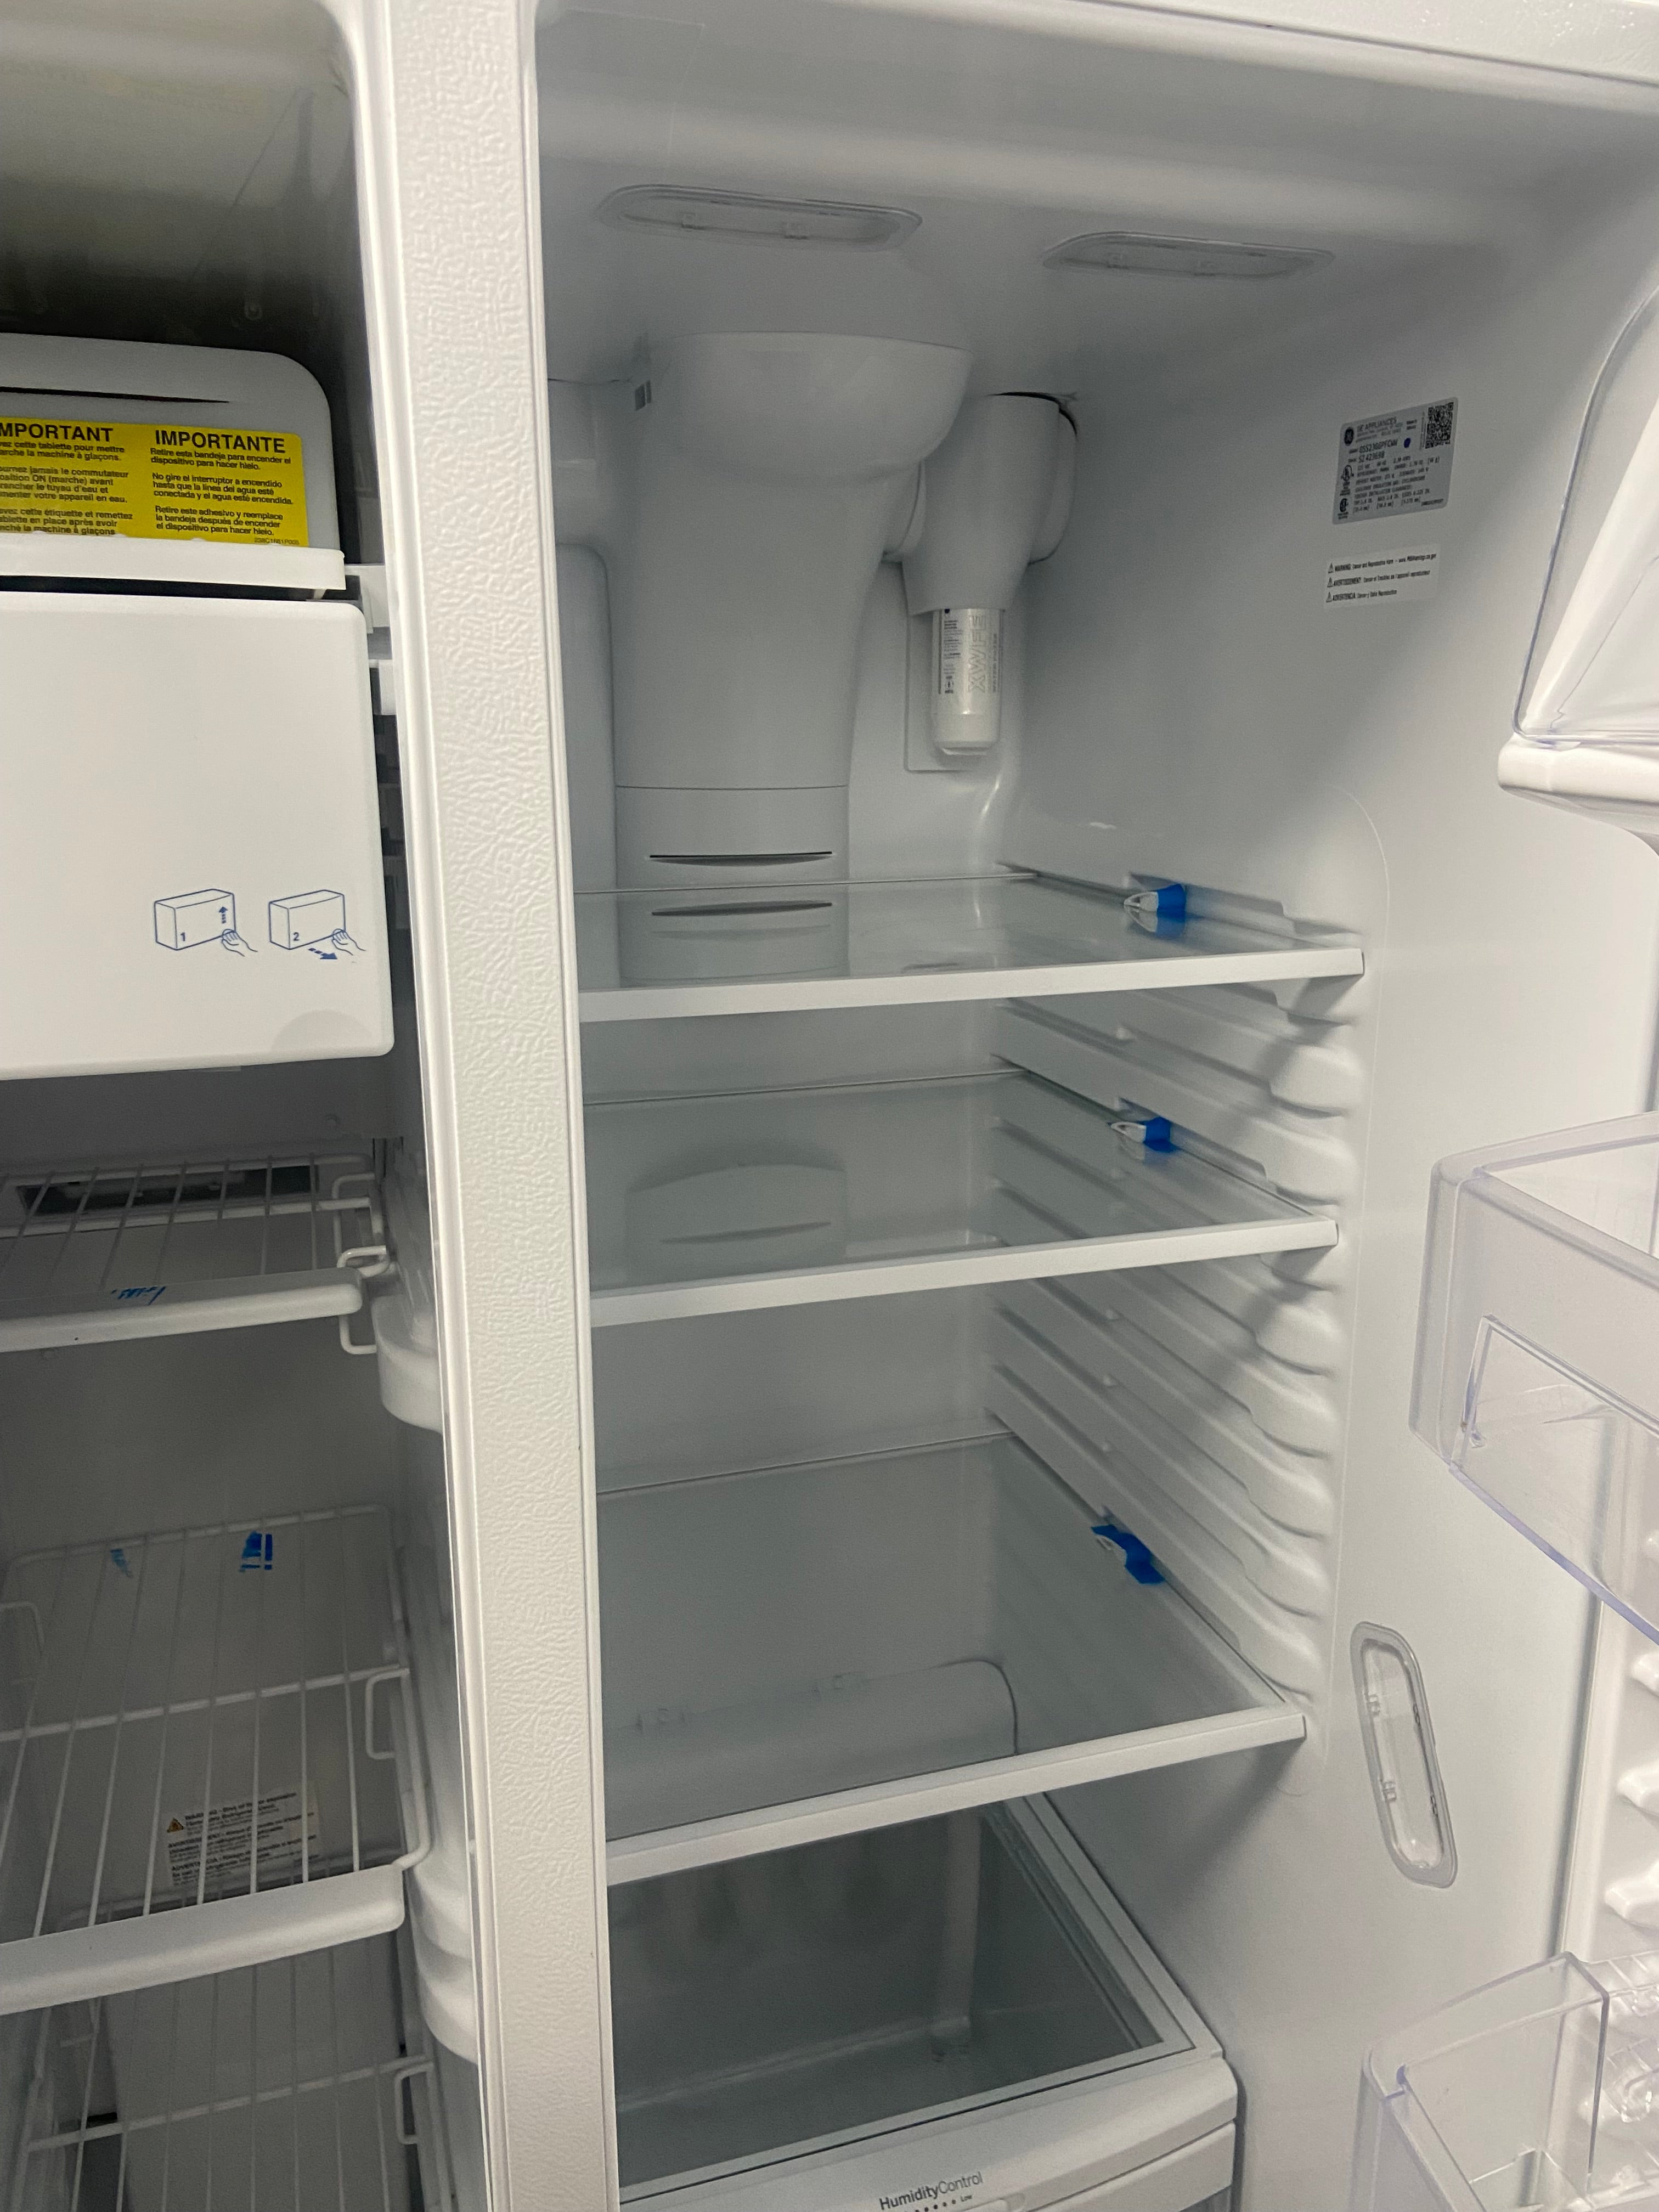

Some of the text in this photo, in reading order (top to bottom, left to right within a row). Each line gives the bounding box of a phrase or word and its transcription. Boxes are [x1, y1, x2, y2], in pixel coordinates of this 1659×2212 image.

[155, 430, 285, 453] IMPORTANTE
[37, 450, 75, 459] machine
[150, 447, 174, 456] Retire
[195, 451, 225, 460] bandeja
[228, 454, 245, 462] para
[247, 455, 281, 464] encender
[151, 456, 261, 470] dispositivo para hacer hielo.
[30, 466, 58, 475] jamais
[71, 469, 128, 478] commutateur
[49, 476, 87, 485] (marche)
[166, 474, 181, 483] gire
[192, 475, 233, 486] interruptor
[242, 479, 283, 488] encendido
[47, 484, 71, 493] tuyau
[153, 481, 175, 489] hasta
[177, 483, 192, 492] que
[194, 483, 201, 491] la
[223, 485, 235, 493] del
[59, 493, 93, 502] appareil
[154, 490, 195, 499] conectada
[252, 495, 294, 505] encendida.
[44, 509, 83, 518] étiquette
[96, 511, 133, 520] remettez
[155, 506, 179, 514] Retire
[199, 509, 234, 517] adhesivo
[243, 511, 283, 520] reemplace
[43, 517, 67, 527] place
[69, 518, 93, 528] après
[165, 515, 196, 523] bandeja
[198, 517, 232, 526] después
[245, 520, 280, 528] encender
[166, 523, 208, 532] dispositivo
[34, 525, 71, 533] machine
[968, 615, 986, 693] XWFE
[180, 932, 186, 941] 1
[293, 932, 300, 941] 2
[879, 2171, 983, 2210] HumidityControl
